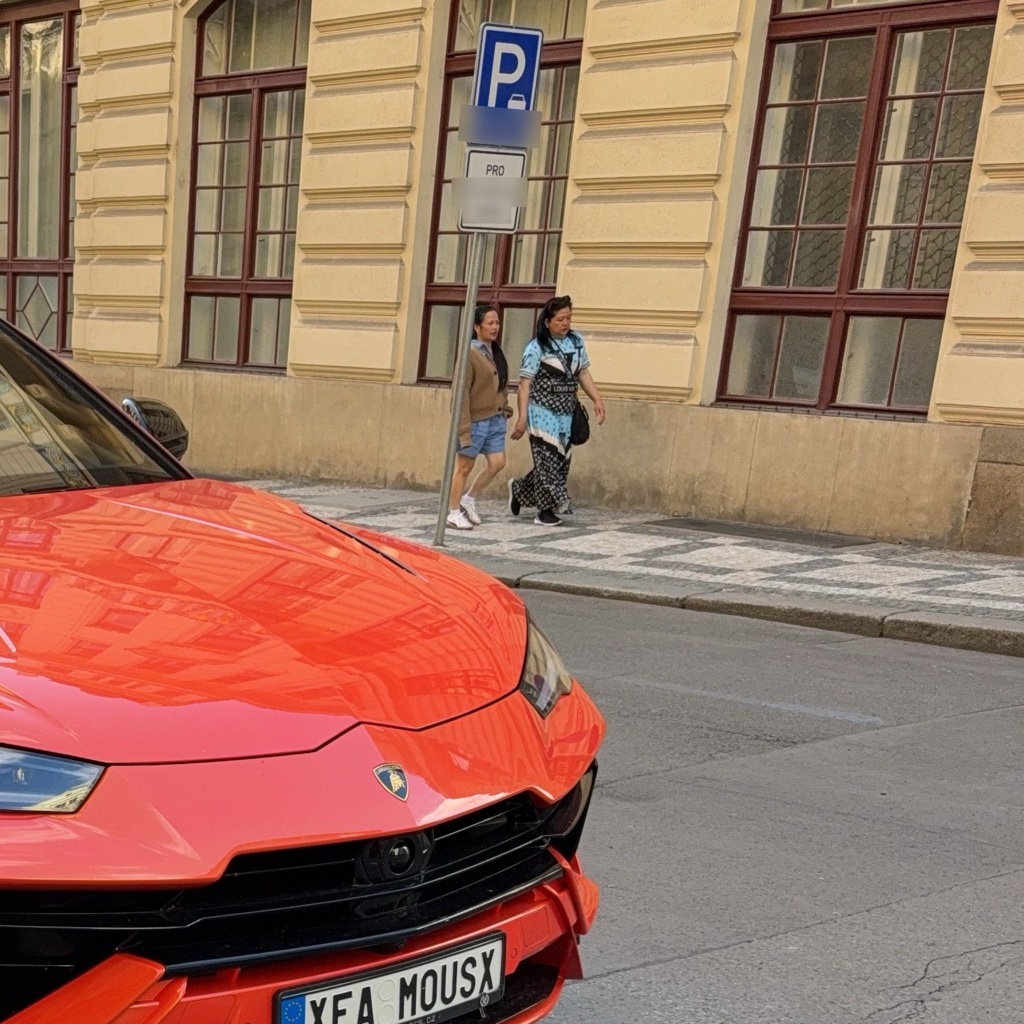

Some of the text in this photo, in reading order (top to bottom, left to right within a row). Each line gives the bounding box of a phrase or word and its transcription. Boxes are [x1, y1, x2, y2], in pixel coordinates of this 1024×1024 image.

[488, 41, 526, 108] P
[486, 164, 505, 177] PRO
[398, 948, 496, 1020] MOUSX
